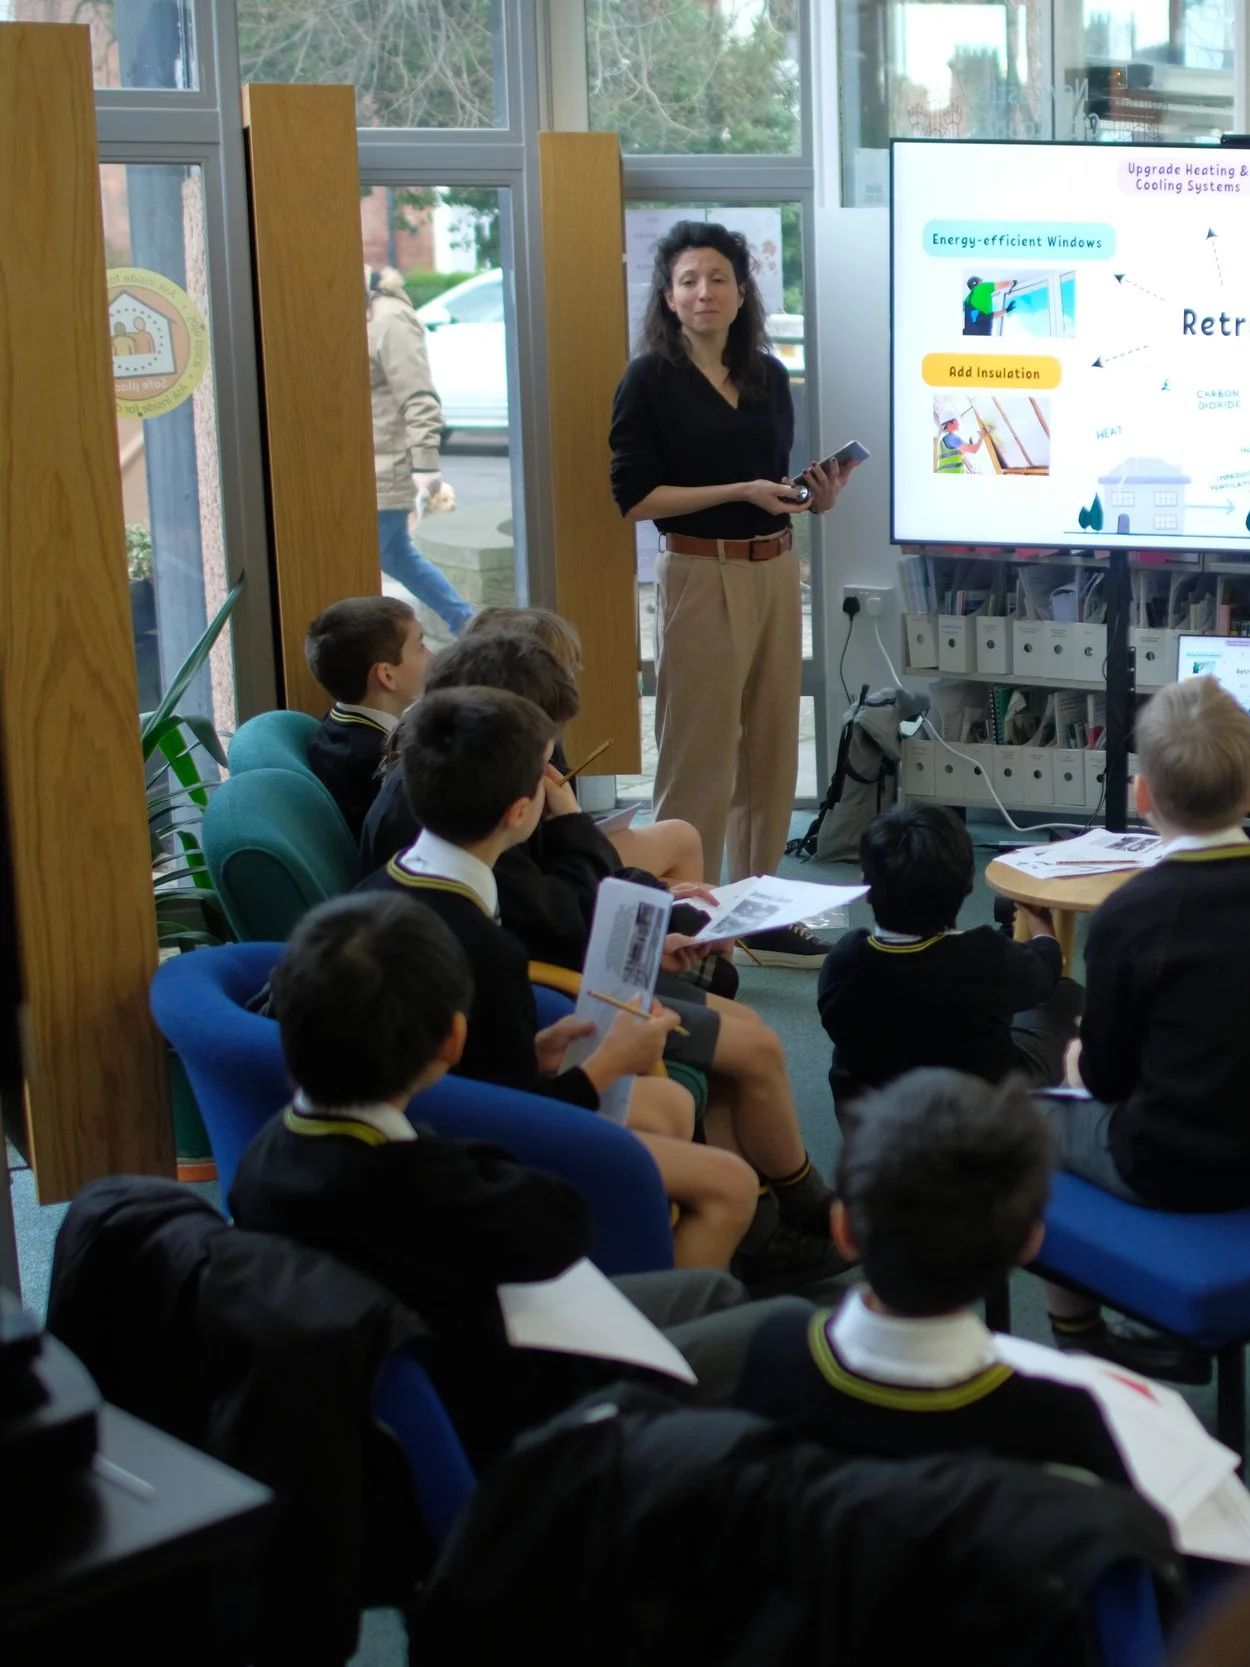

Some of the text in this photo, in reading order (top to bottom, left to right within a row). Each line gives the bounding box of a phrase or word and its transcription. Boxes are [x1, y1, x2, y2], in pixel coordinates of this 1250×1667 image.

[1127, 162, 1249, 180] Upgrade Heating &
[1136, 178, 1241, 194] Cooling Systems
[932, 232, 1103, 250] Energy-efficient Windows
[949, 366, 1040, 379] Add Insulation
[1196, 389, 1240, 398] CARBON
[1198, 400, 1241, 410] DIOXIDE
[1096, 426, 1122, 440] HEAT
